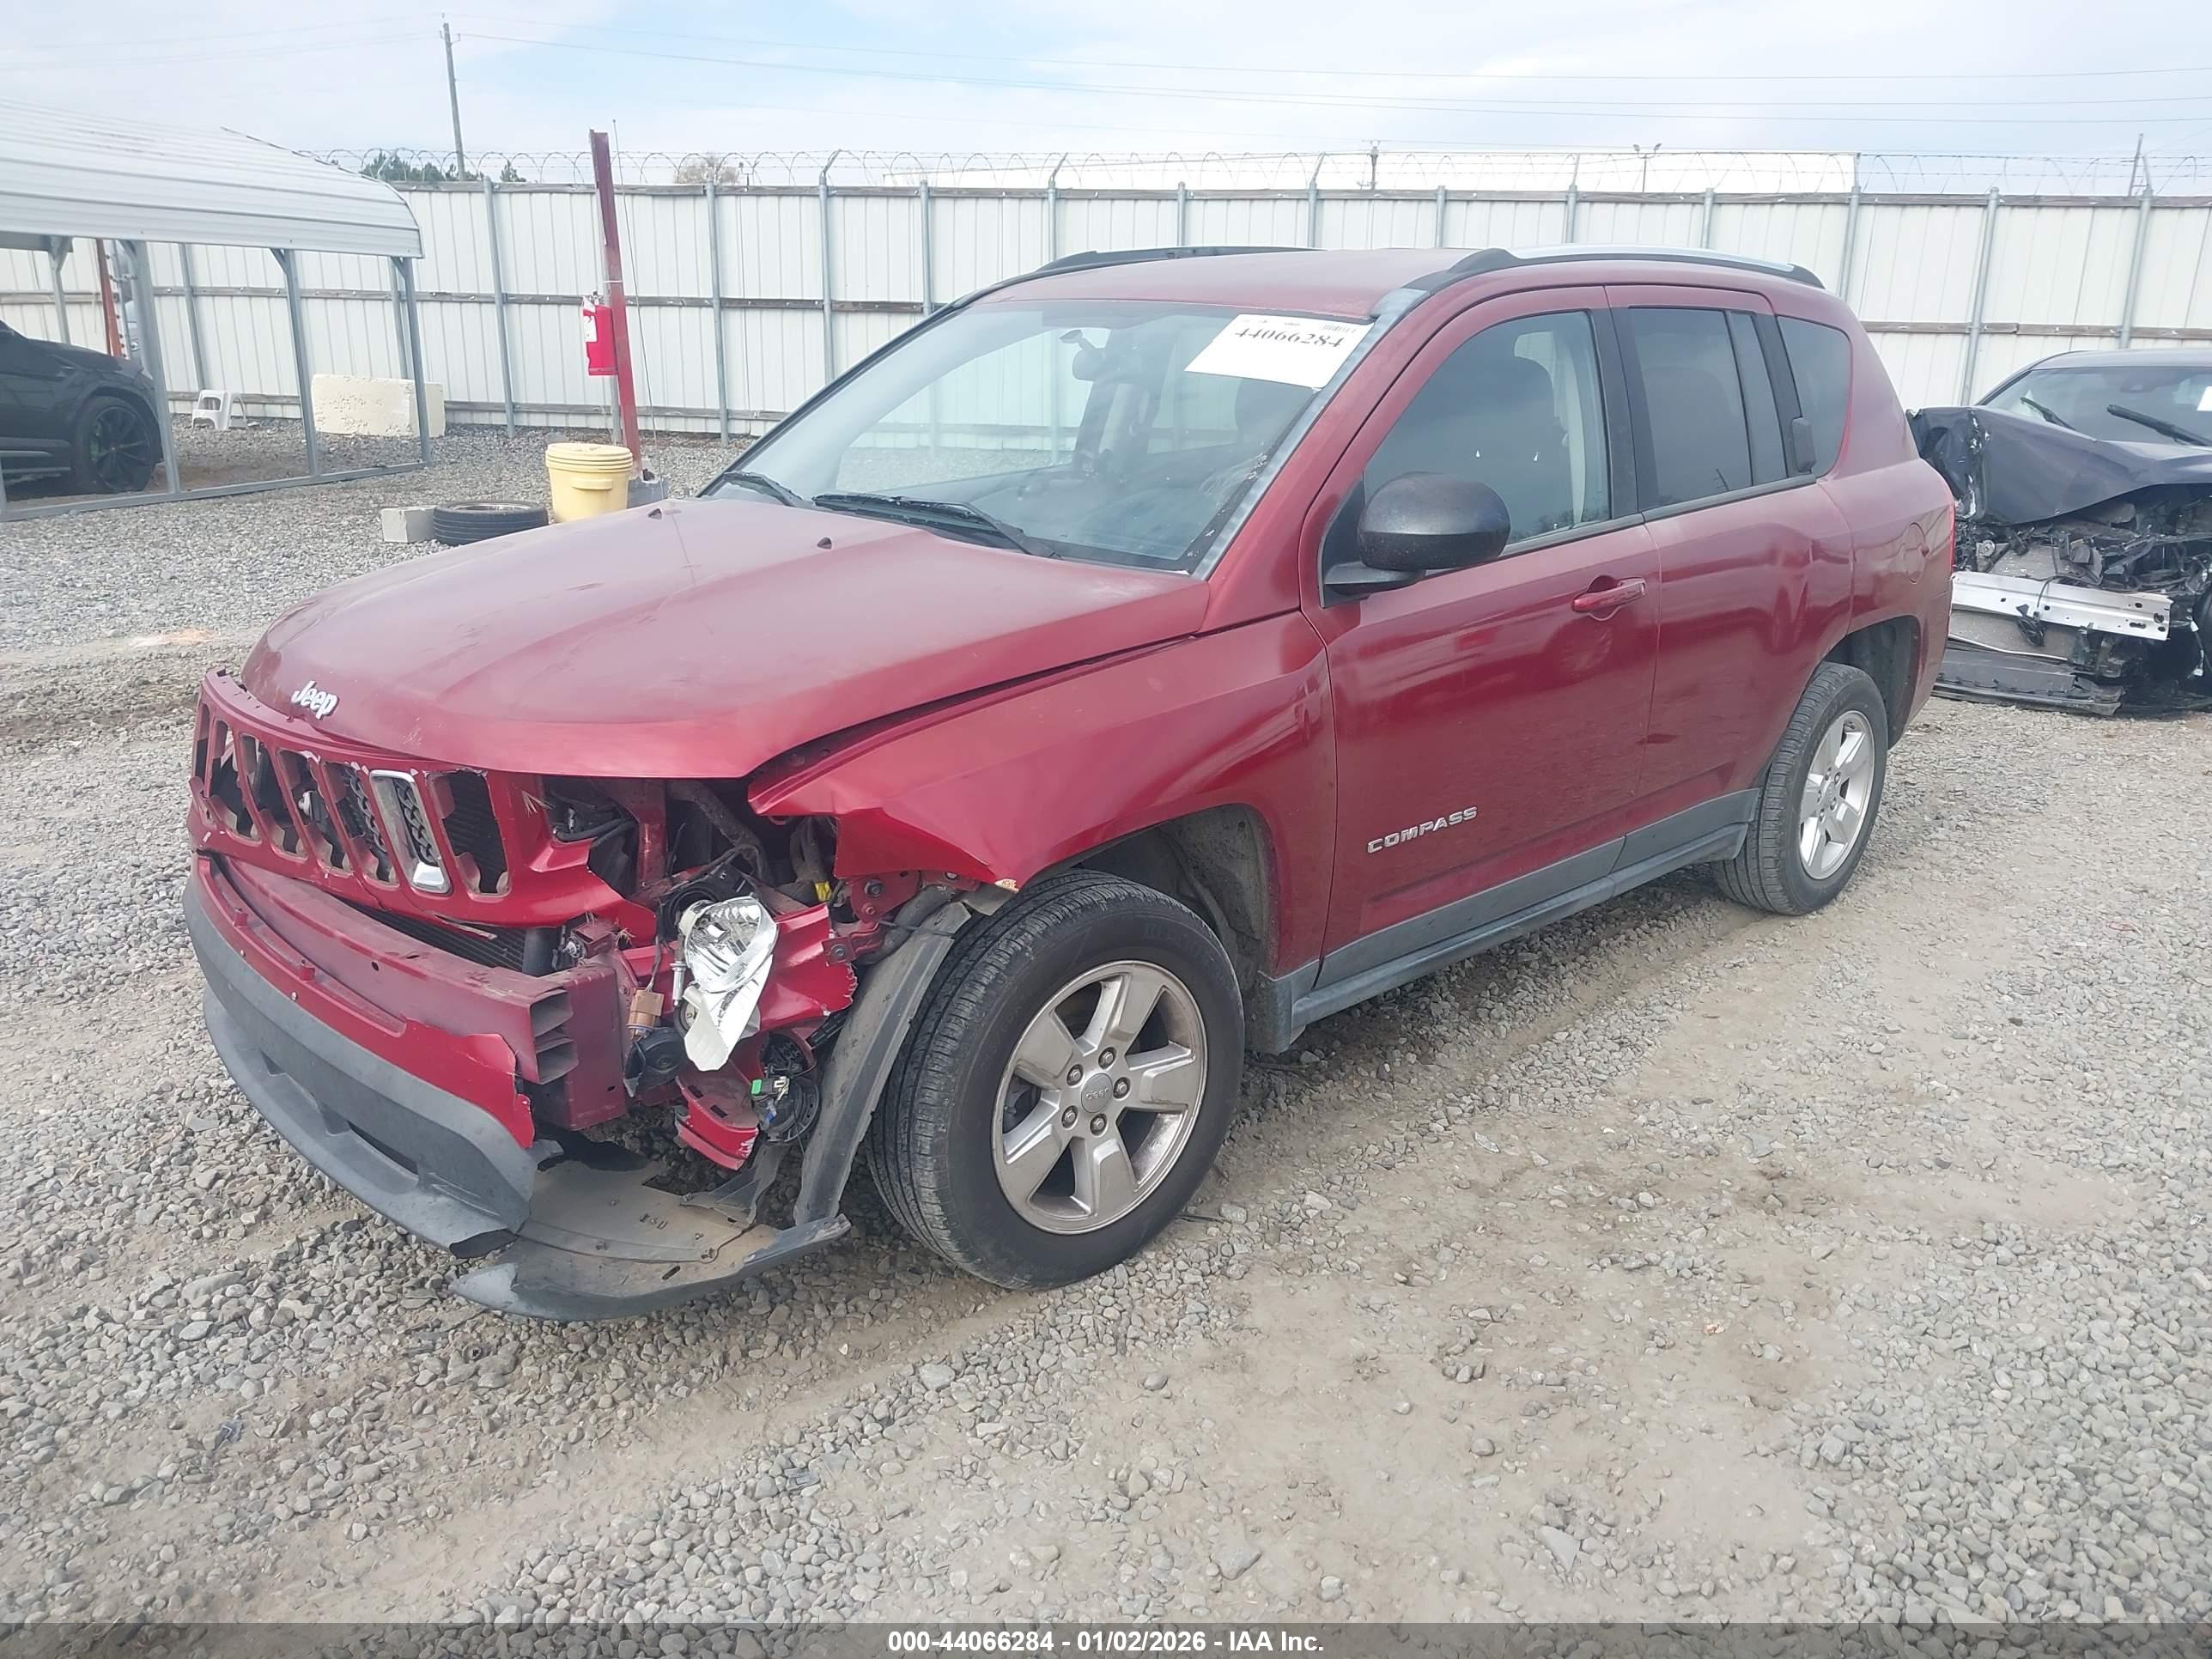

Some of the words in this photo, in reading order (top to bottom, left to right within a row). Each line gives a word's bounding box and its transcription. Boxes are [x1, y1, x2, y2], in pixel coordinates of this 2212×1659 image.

[1235, 327, 1346, 348] 44066284
[291, 680, 338, 720] Jeep
[1367, 806, 1478, 854] COMPASS
